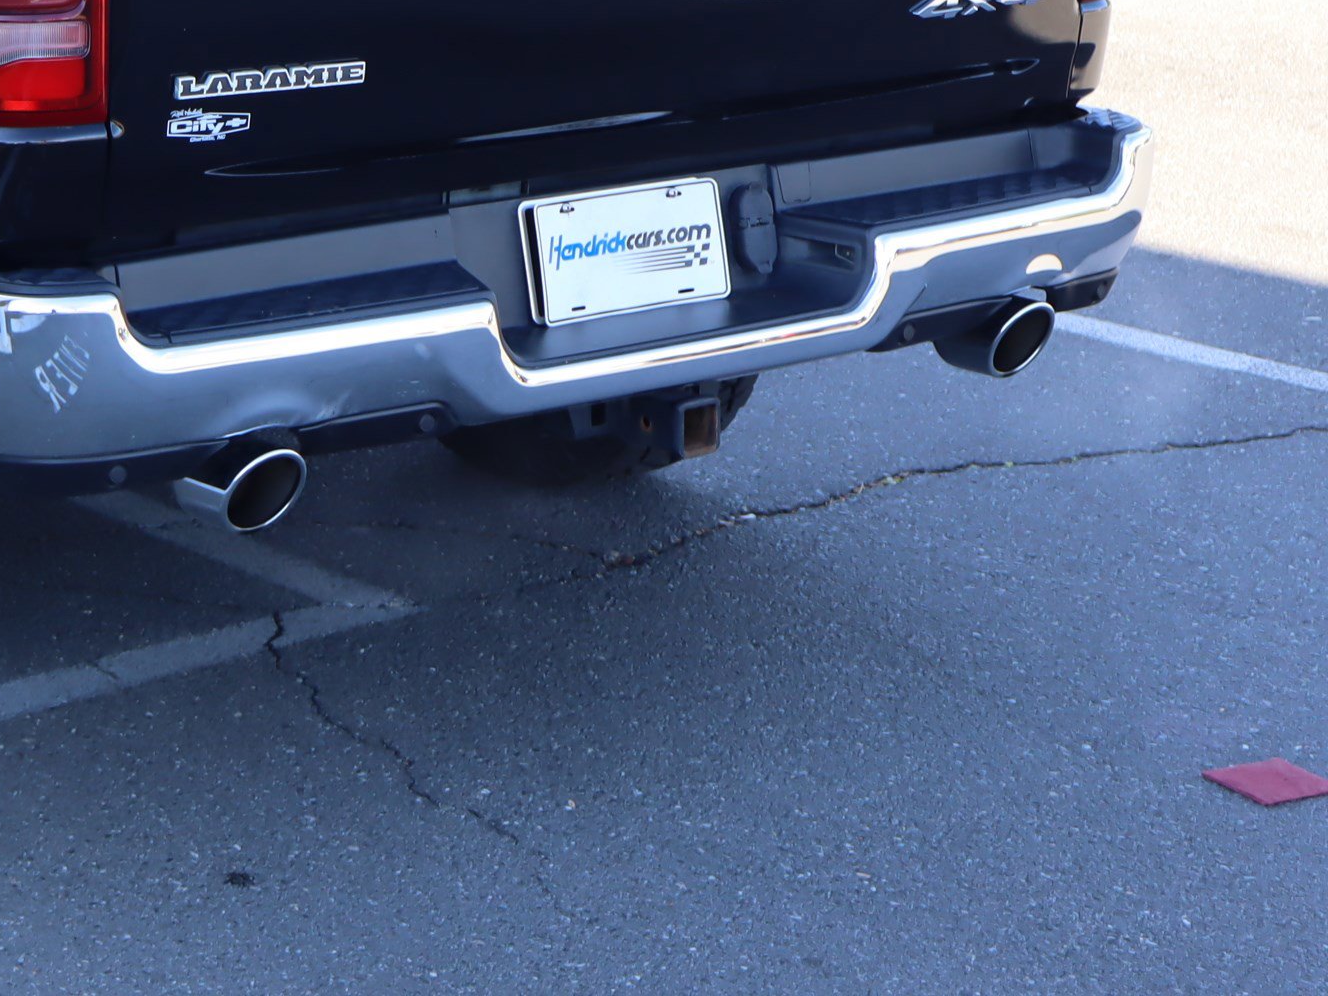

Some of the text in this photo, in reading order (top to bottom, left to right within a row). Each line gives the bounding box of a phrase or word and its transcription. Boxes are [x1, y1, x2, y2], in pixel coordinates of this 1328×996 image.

[174, 60, 367, 101] LARAMIE
[170, 118, 225, 135] City
[548, 223, 712, 271] Hendrickcars.com
